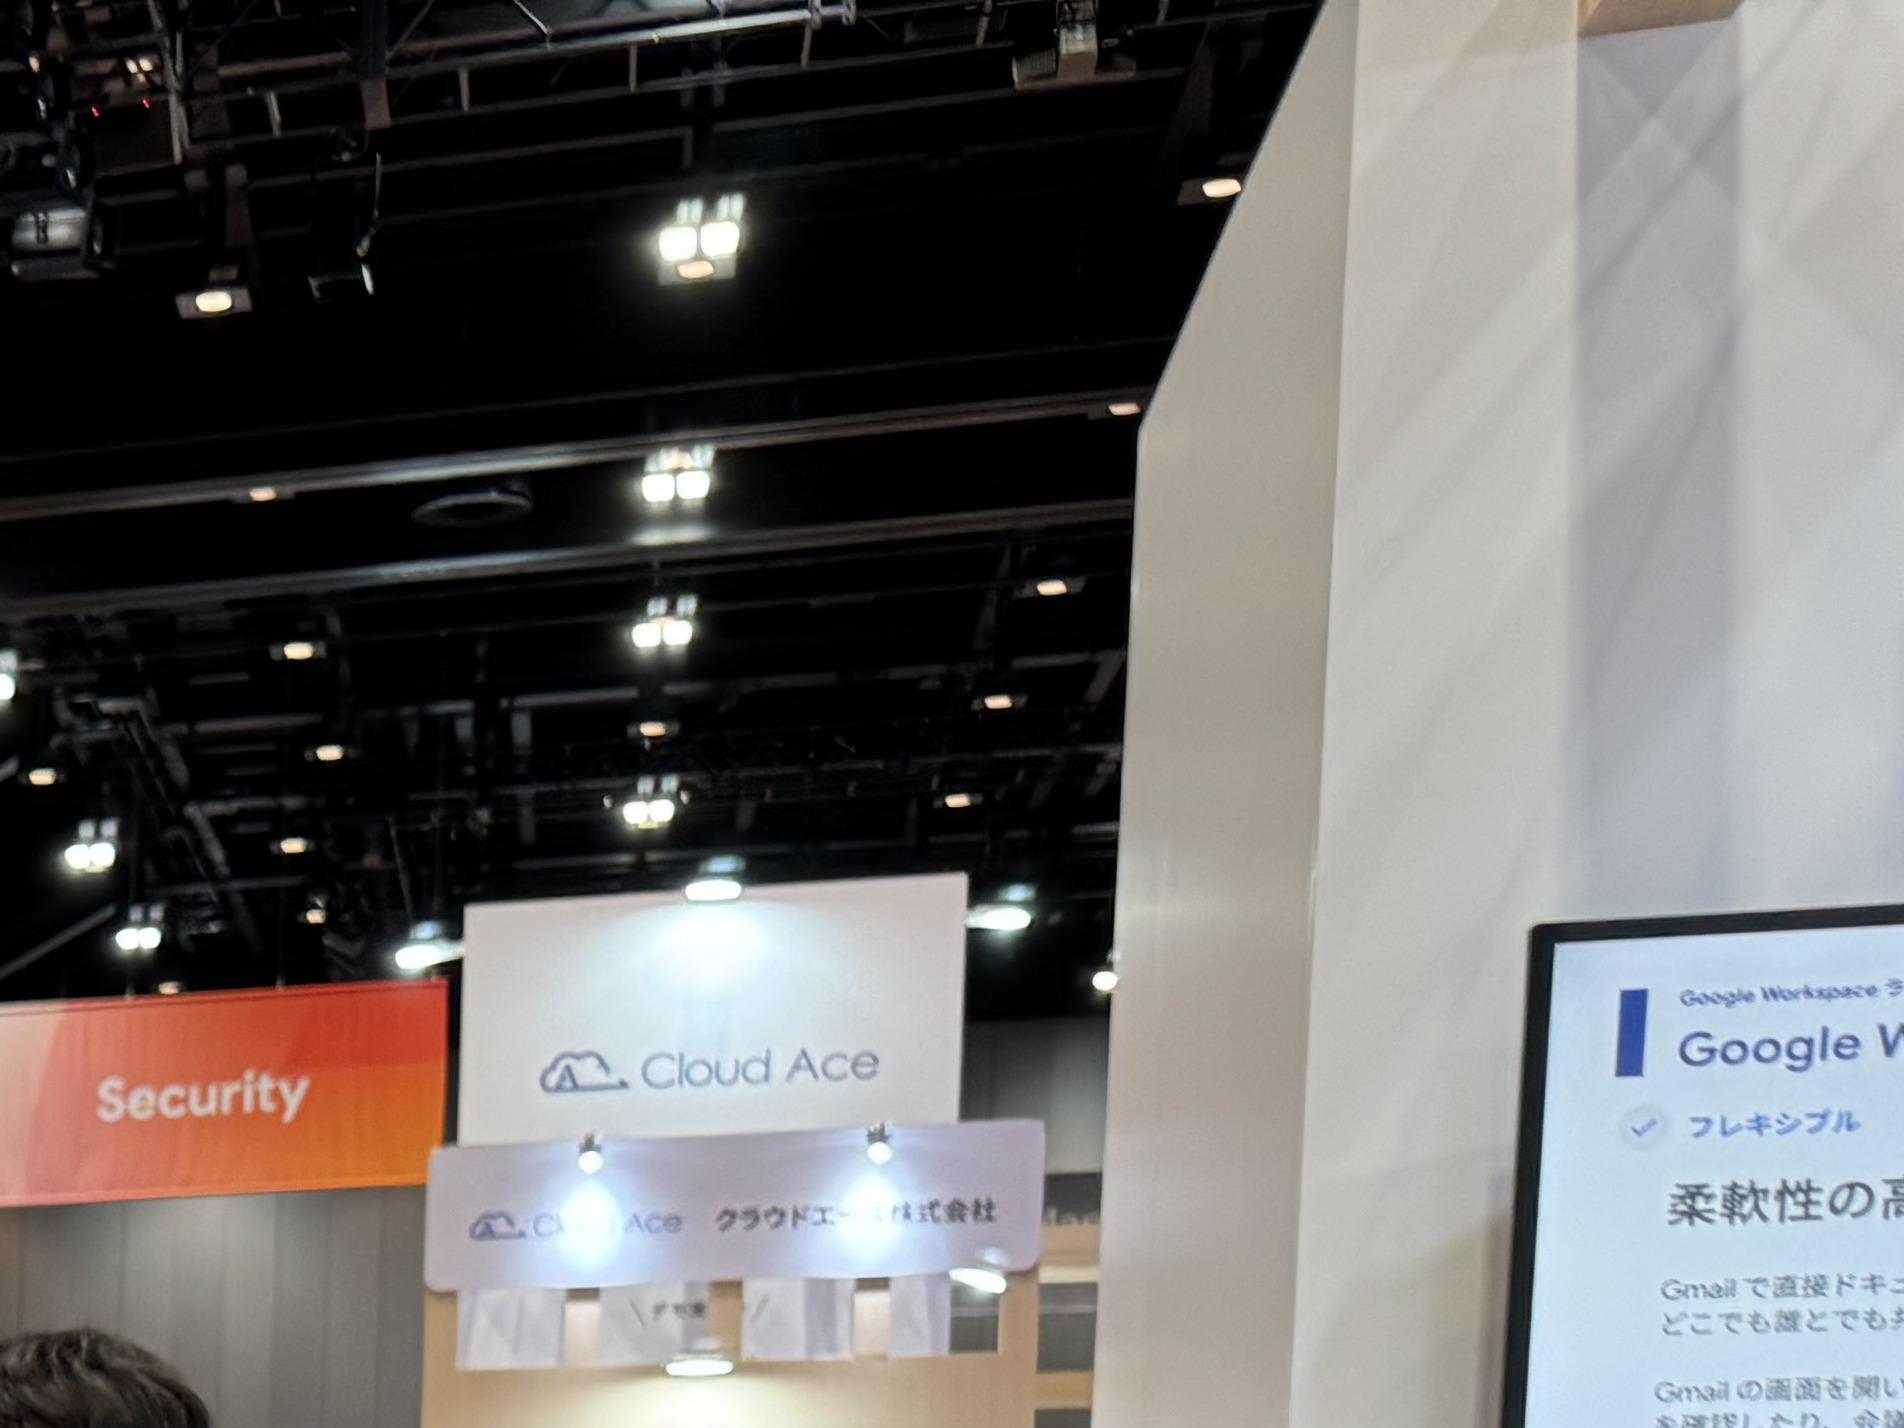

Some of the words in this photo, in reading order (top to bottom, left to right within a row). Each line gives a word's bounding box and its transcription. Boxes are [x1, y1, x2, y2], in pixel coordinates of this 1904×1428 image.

[1679, 988, 1756, 1009] Google
[1678, 1030, 1862, 1073] Google
[641, 1049, 770, 1090] Cloud
[784, 1047, 880, 1084] Ace
[96, 1071, 310, 1124] Security
[1689, 1109, 1863, 1139] フレキシブル
[715, 1199, 998, 1234] クラウドエー株式会社
[1660, 1276, 1737, 1302] Gmail
[1653, 1379, 1731, 1404] Gmail
